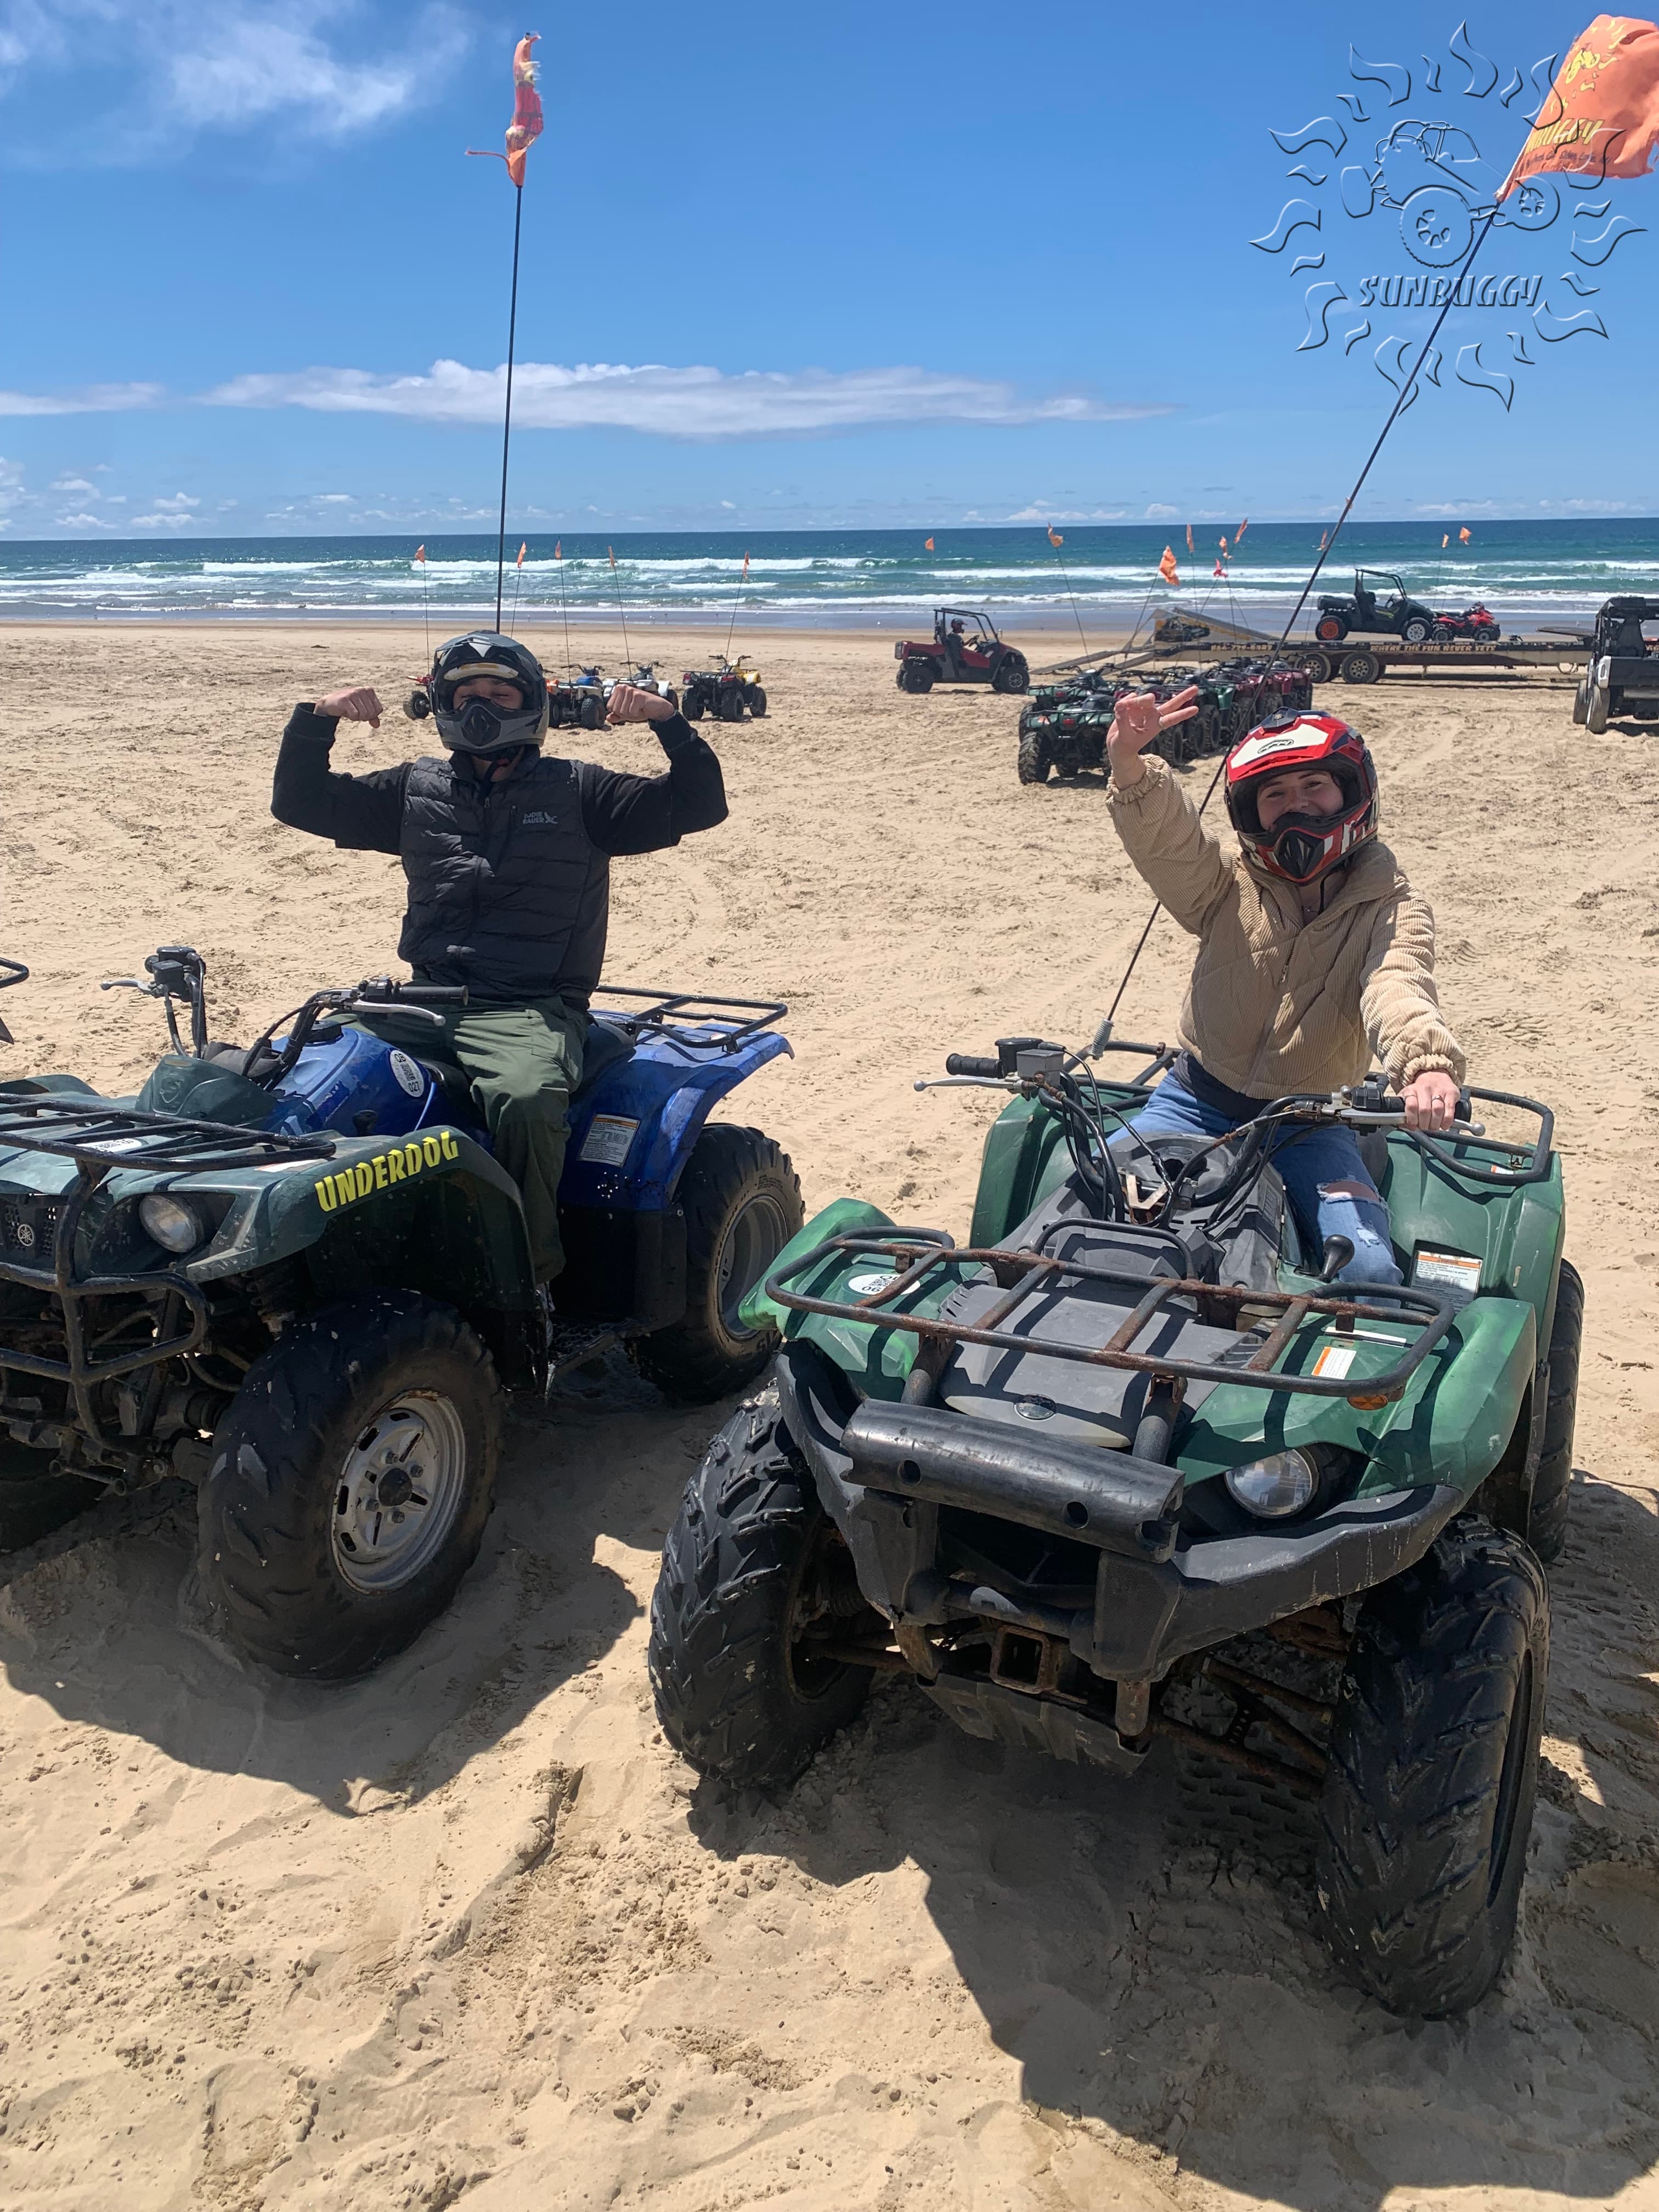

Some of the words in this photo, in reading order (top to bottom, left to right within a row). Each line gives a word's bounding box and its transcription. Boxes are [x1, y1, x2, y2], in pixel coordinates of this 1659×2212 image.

[394, 1053, 407, 1063] QB
[408, 1081, 421, 1092] 027
[314, 1131, 459, 1212] UNDERDOG
